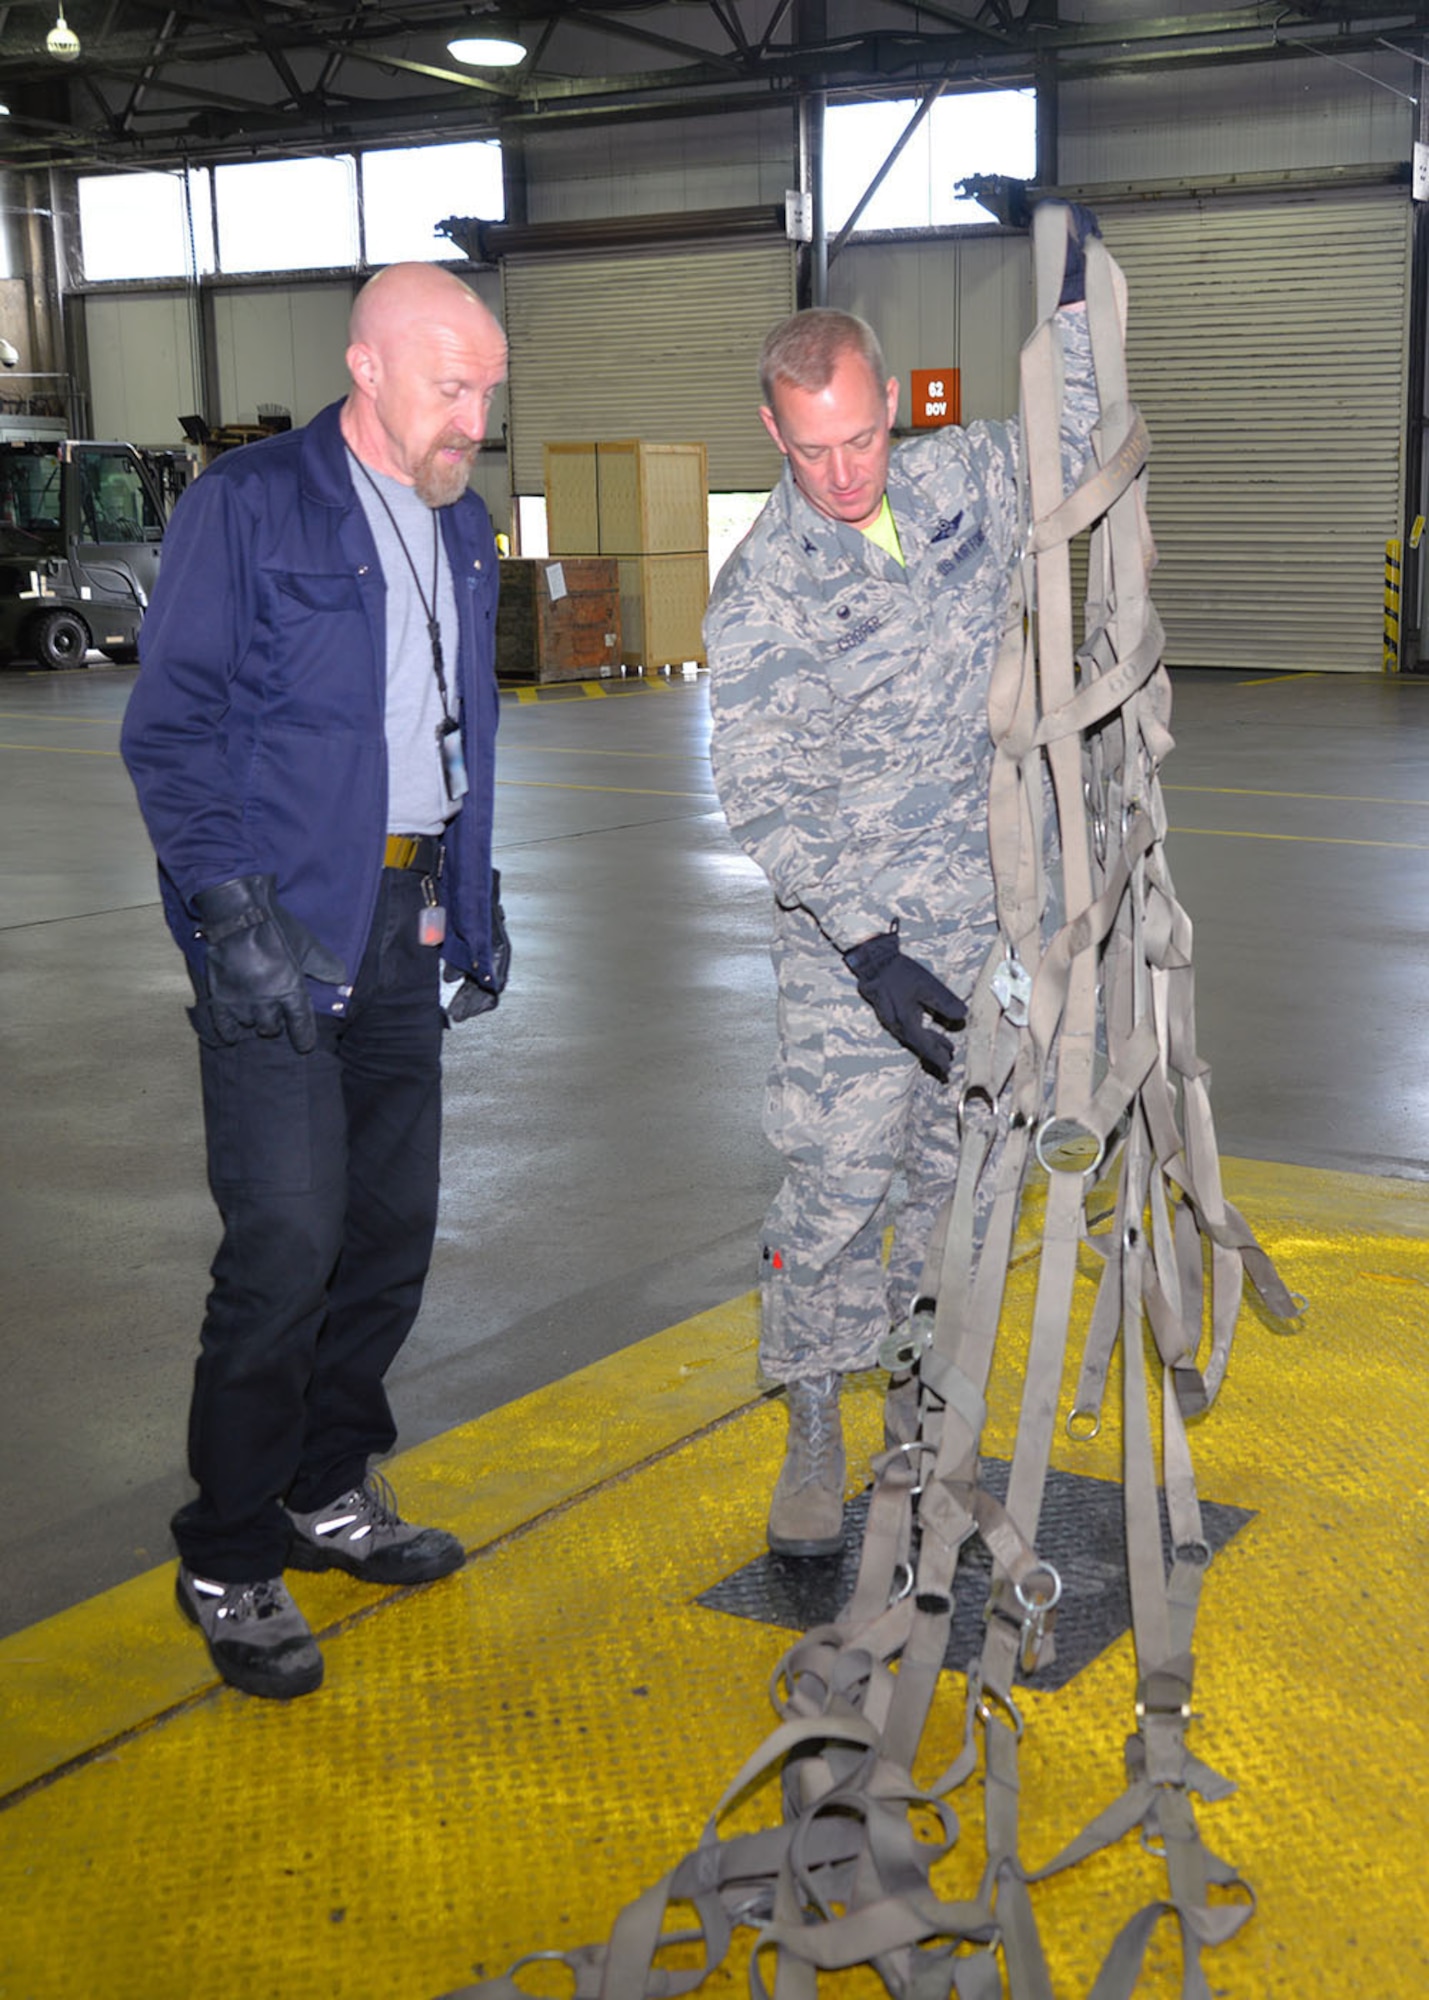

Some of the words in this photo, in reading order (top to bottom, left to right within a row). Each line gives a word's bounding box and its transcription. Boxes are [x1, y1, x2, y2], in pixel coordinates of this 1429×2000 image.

[928, 380, 944, 398] 62
[925, 401, 947, 417] DOV
[837, 615, 881, 651] COOPER
